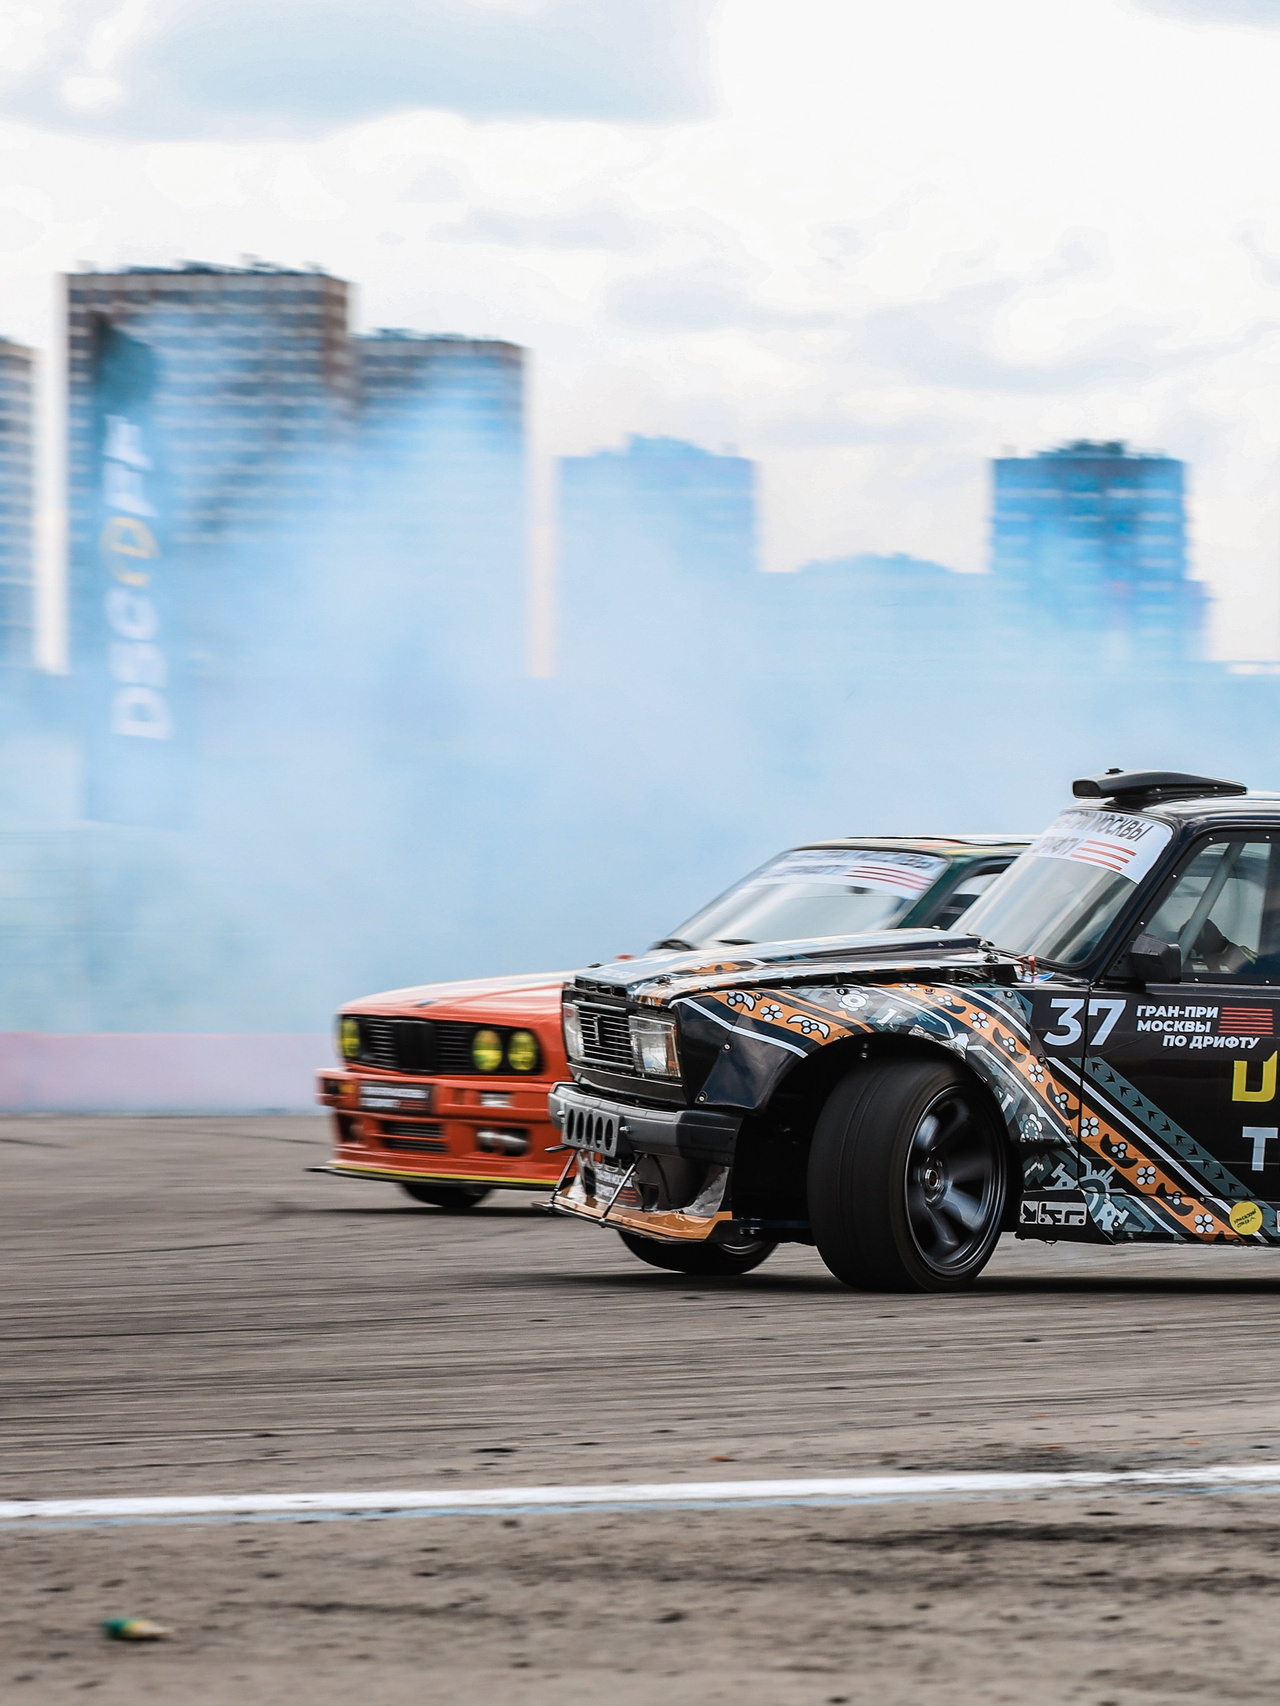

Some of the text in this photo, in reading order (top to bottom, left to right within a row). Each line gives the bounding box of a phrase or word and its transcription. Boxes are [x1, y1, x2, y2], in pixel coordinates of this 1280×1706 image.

[1136, 1005, 1219, 1018] ГРАН-ПРИ
[1043, 998, 1127, 1047] 37
[1136, 1020, 1212, 1033] МОСКВЫ
[1162, 1035, 1260, 1049] ПО ДРИФТУ
